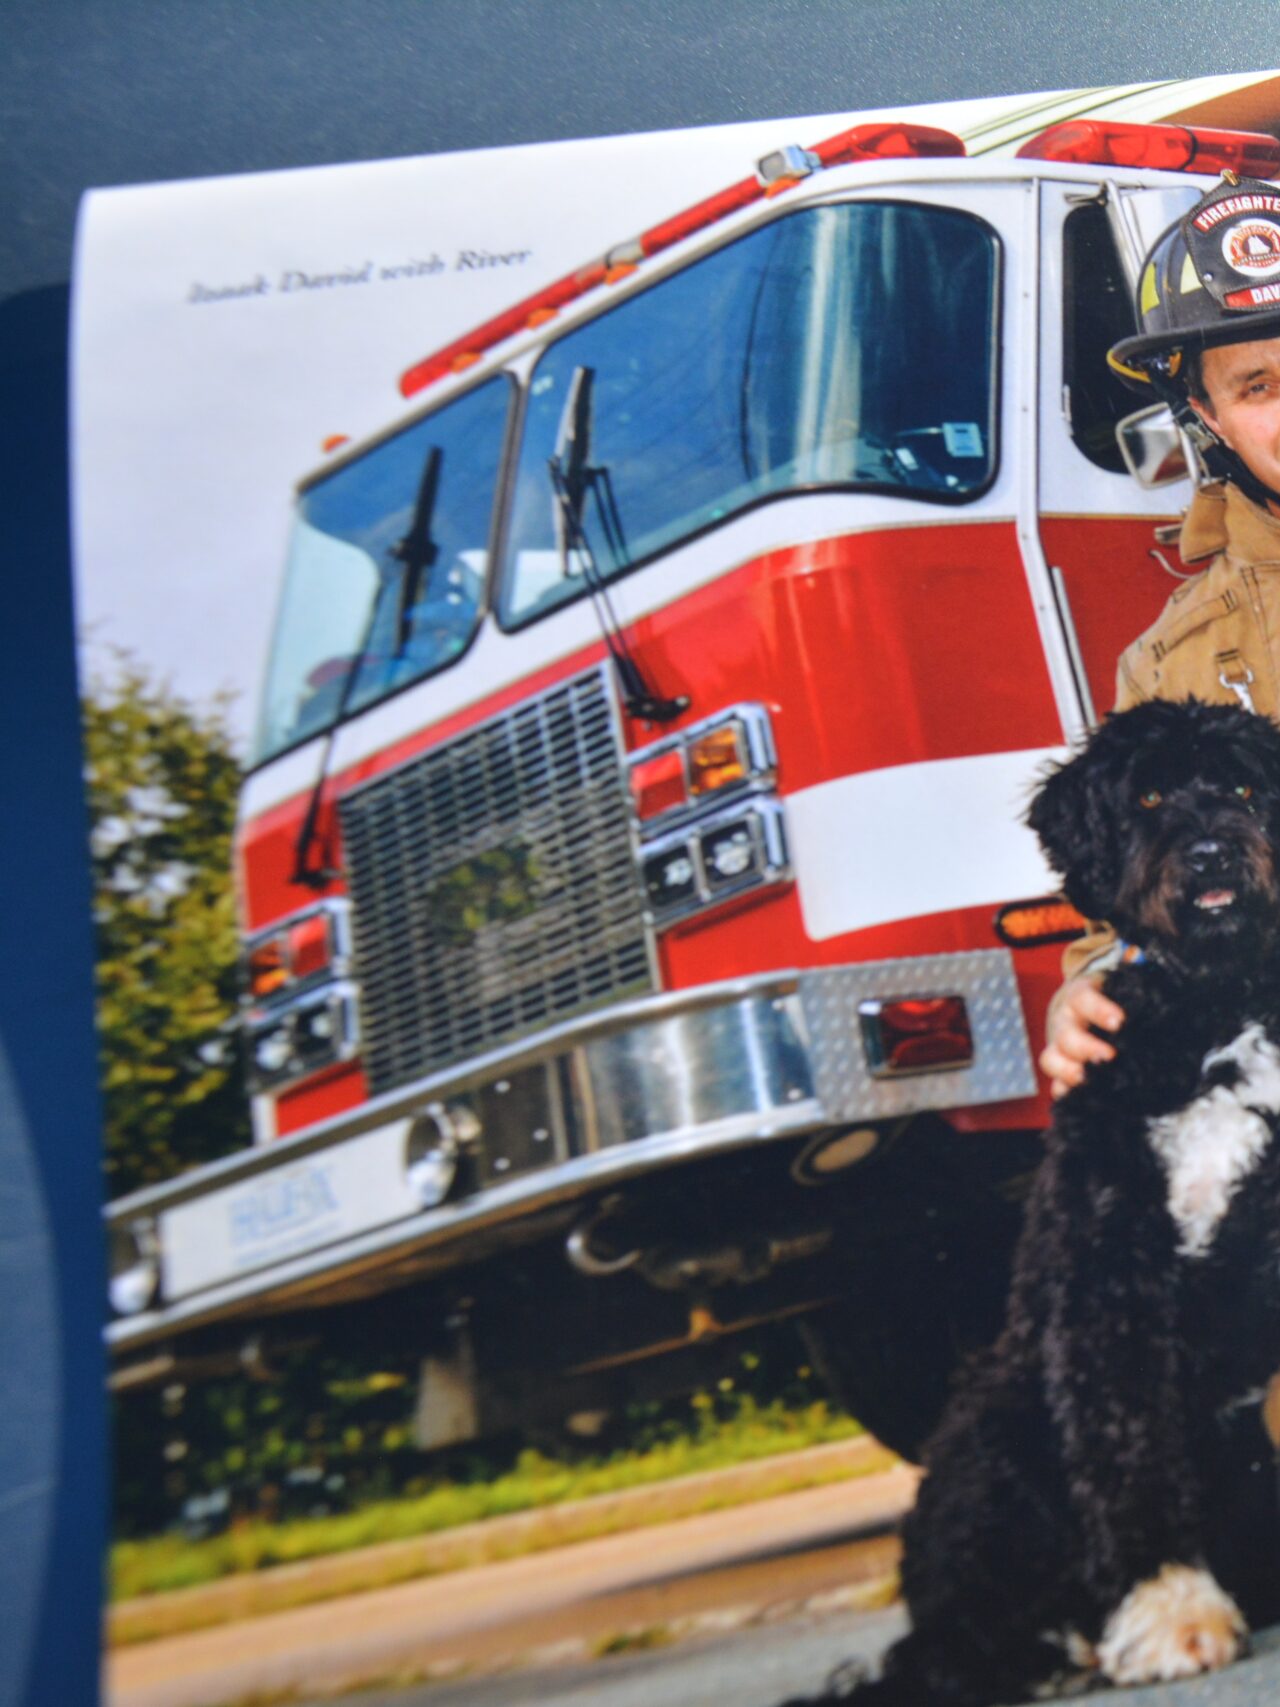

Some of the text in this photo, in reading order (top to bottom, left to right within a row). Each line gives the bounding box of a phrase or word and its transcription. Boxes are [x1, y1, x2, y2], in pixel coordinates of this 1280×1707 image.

[278, 260, 374, 293] David
[379, 253, 446, 282] with
[455, 249, 533, 273] River
